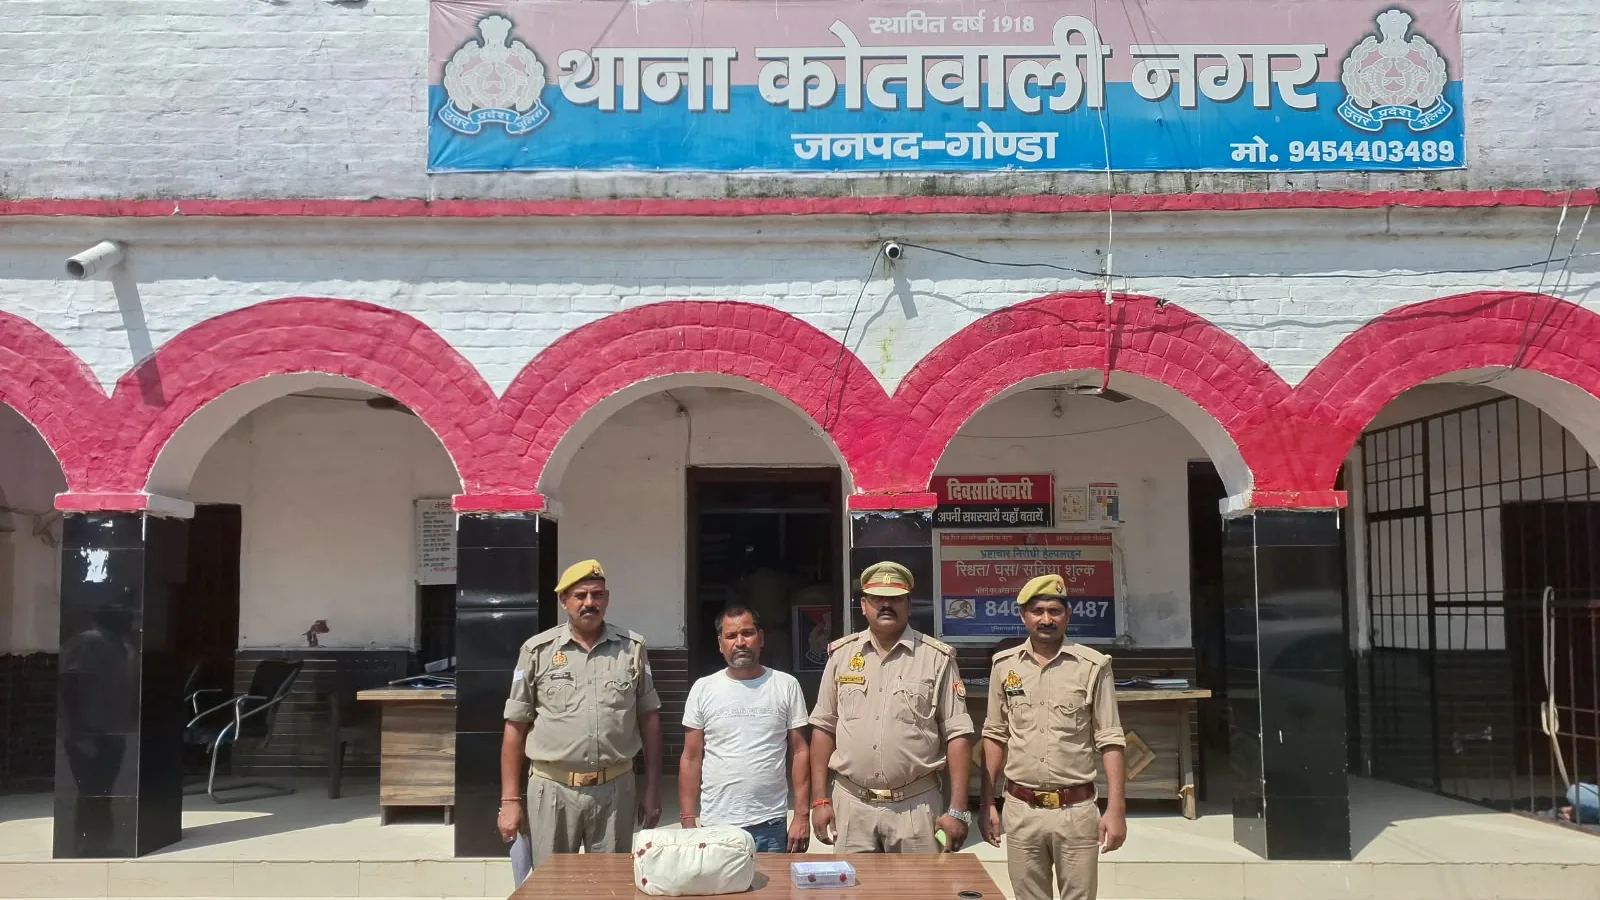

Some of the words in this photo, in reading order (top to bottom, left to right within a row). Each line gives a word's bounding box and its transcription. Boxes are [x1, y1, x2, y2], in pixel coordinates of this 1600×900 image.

[868, 10, 944, 34] स्थापित
[952, 9, 985, 33] वर्ष
[992, 15, 1034, 33] 1918
[557, 46, 738, 113] थाना
[755, 16, 1112, 113] कोतवाली
[1129, 43, 1327, 110] नगर
[478, 109, 510, 121] प्रदेश
[1377, 106, 1412, 118] प्रदेश
[1418, 105, 1446, 127] पुलिस
[791, 121, 1059, 162] जनपद-गोण्डा
[1230, 136, 1279, 163] मो.
[1289, 139, 1455, 163] 9454403489
[946, 477, 1034, 500] दिवसाधिकारी
[937, 507, 961, 522] अपनी
[1001, 508, 1020, 523] यहाँ
[994, 563, 1019, 582] घूस/
[1065, 564, 1096, 582] शुल्क
[985, 600, 1109, 618] 846487
